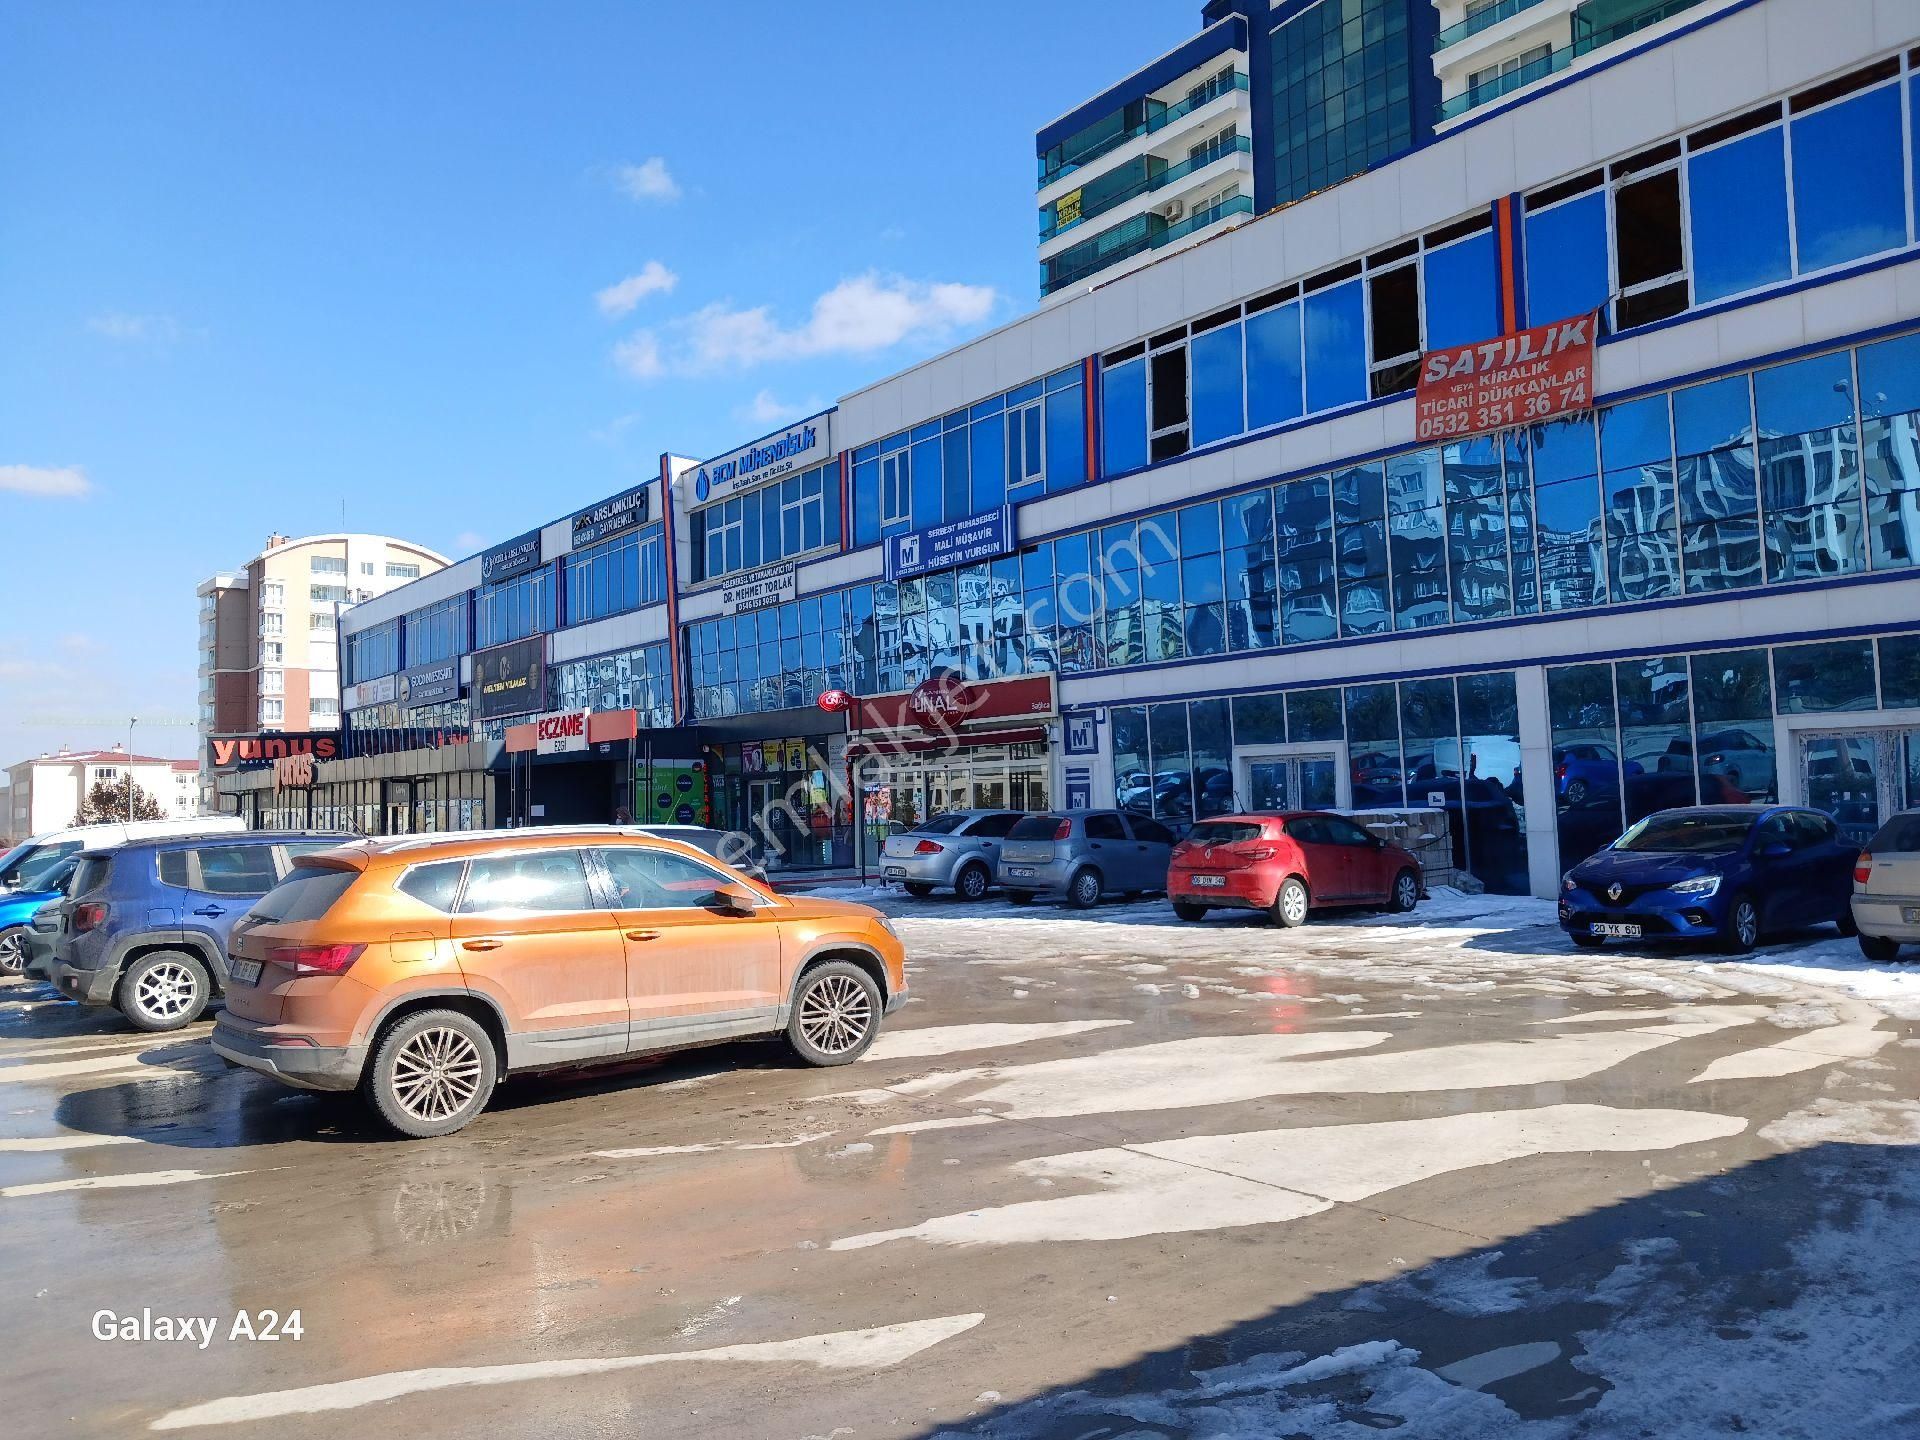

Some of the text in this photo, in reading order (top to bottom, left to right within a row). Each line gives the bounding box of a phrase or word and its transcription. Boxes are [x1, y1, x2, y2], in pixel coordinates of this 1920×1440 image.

[1424, 319, 1588, 383] SATILIK
[1420, 366, 1586, 416] TİCARİ DÜKKANLAR
[1451, 360, 1550, 393] VEYA KİRALIK
[1420, 383, 1586, 438] 0532 351 36 74
[739, 426, 816, 475] MÜHENDİSLİK
[593, 492, 641, 523] ARSLANKILIÇ
[600, 512, 634, 534] GAYRİMENKUL
[928, 510, 999, 538] SERBEST MUHASEBECİ
[935, 536, 953, 552] MALİ
[955, 527, 993, 546] MÜŞAVİR
[928, 542, 1000, 568] HÜSEYİN VURGUN
[724, 576, 793, 604] DR. MEHMET TORLAK
[538, 712, 584, 741] ECZANE
[212, 738, 336, 766] yunus
[273, 752, 314, 798] yunus
[1594, 924, 1640, 935] 20 YK 601
